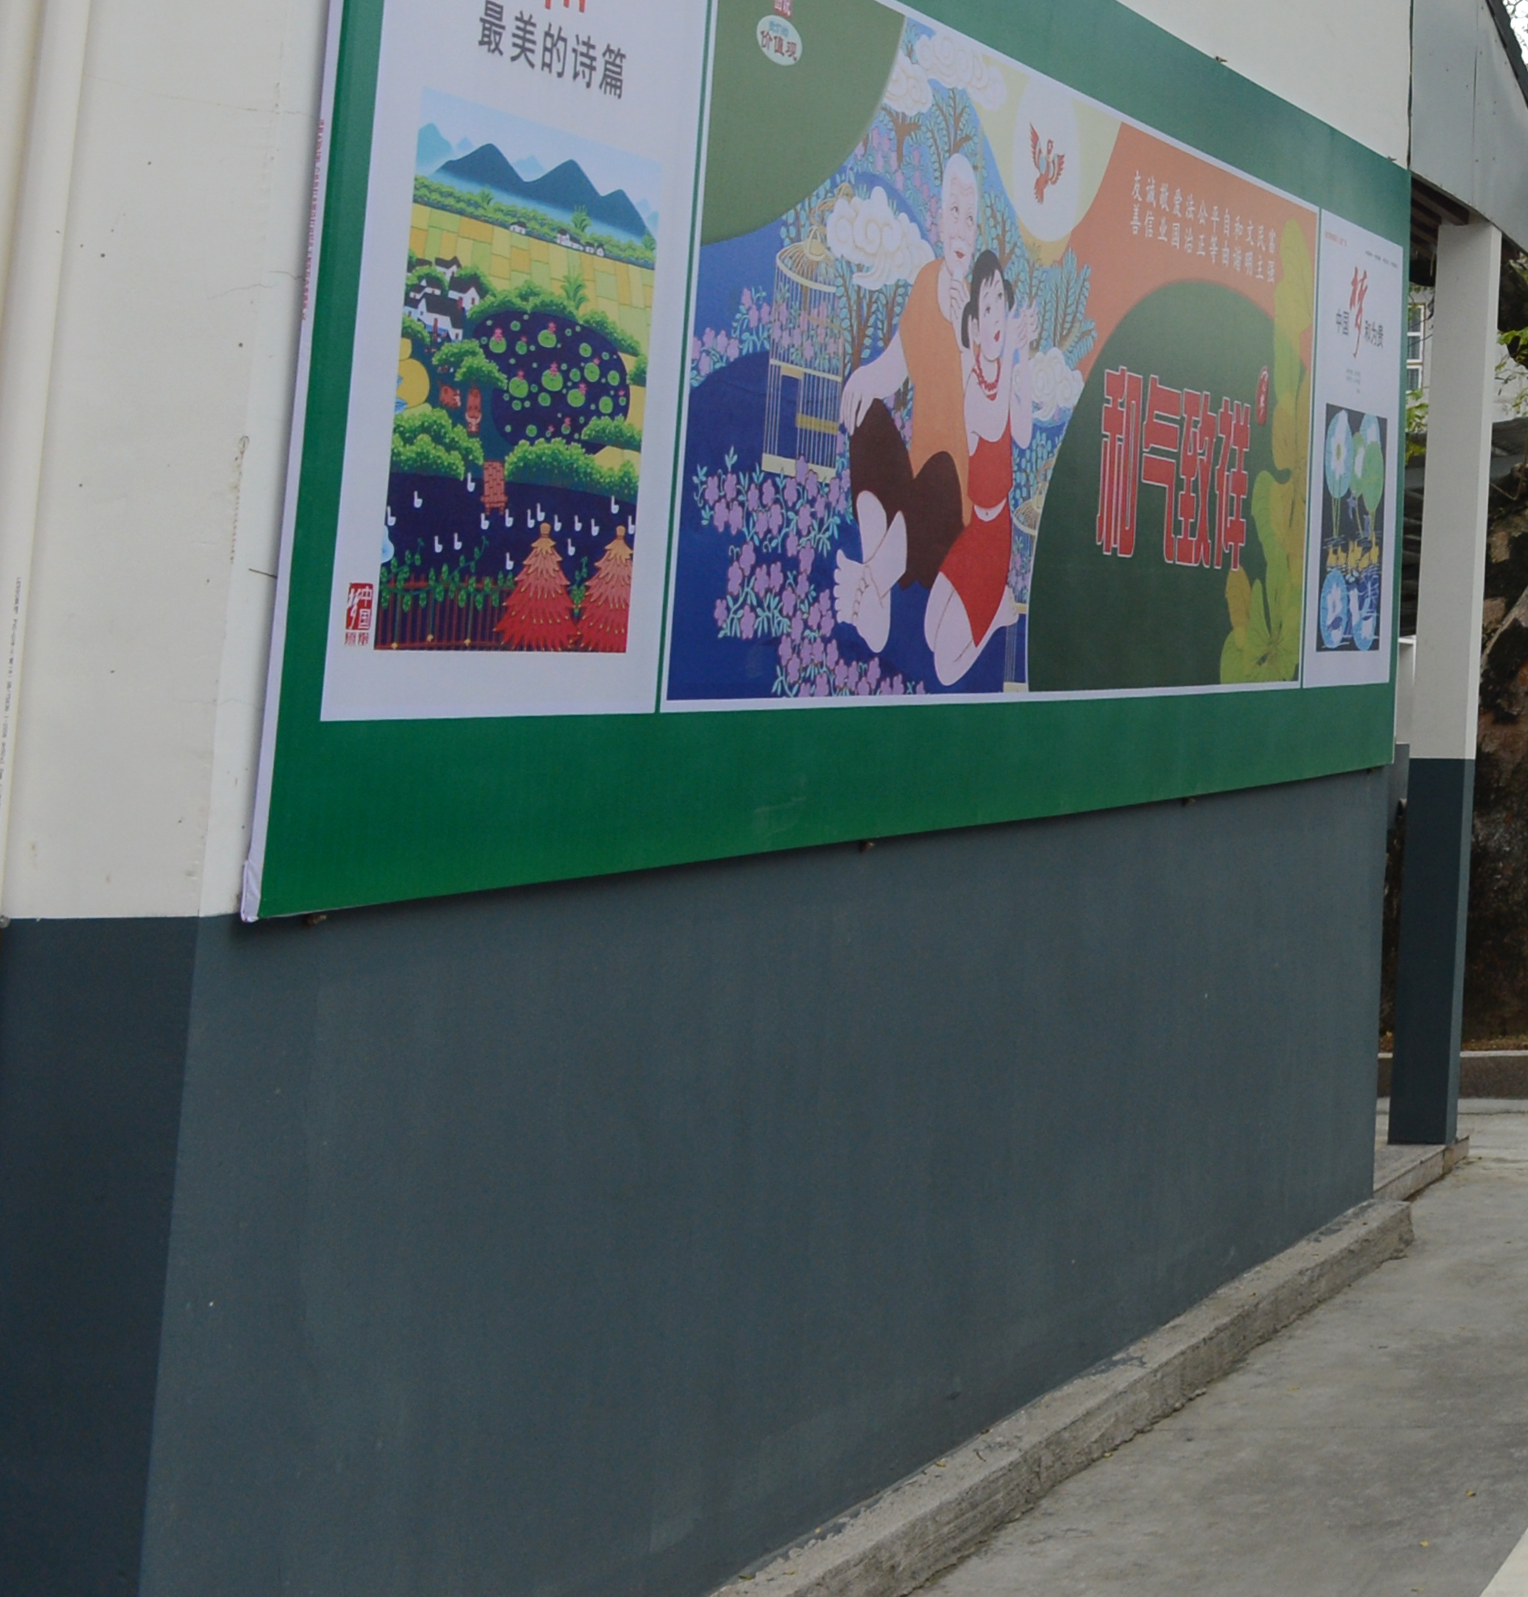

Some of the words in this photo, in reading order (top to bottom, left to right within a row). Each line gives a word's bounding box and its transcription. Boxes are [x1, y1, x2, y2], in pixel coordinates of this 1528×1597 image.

[478, 0, 627, 100] 最美的诗篇
[760, 30, 797, 62] 价值观
[1335, 309, 1350, 337] 中国
[1096, 365, 1251, 572] 和气致祥
